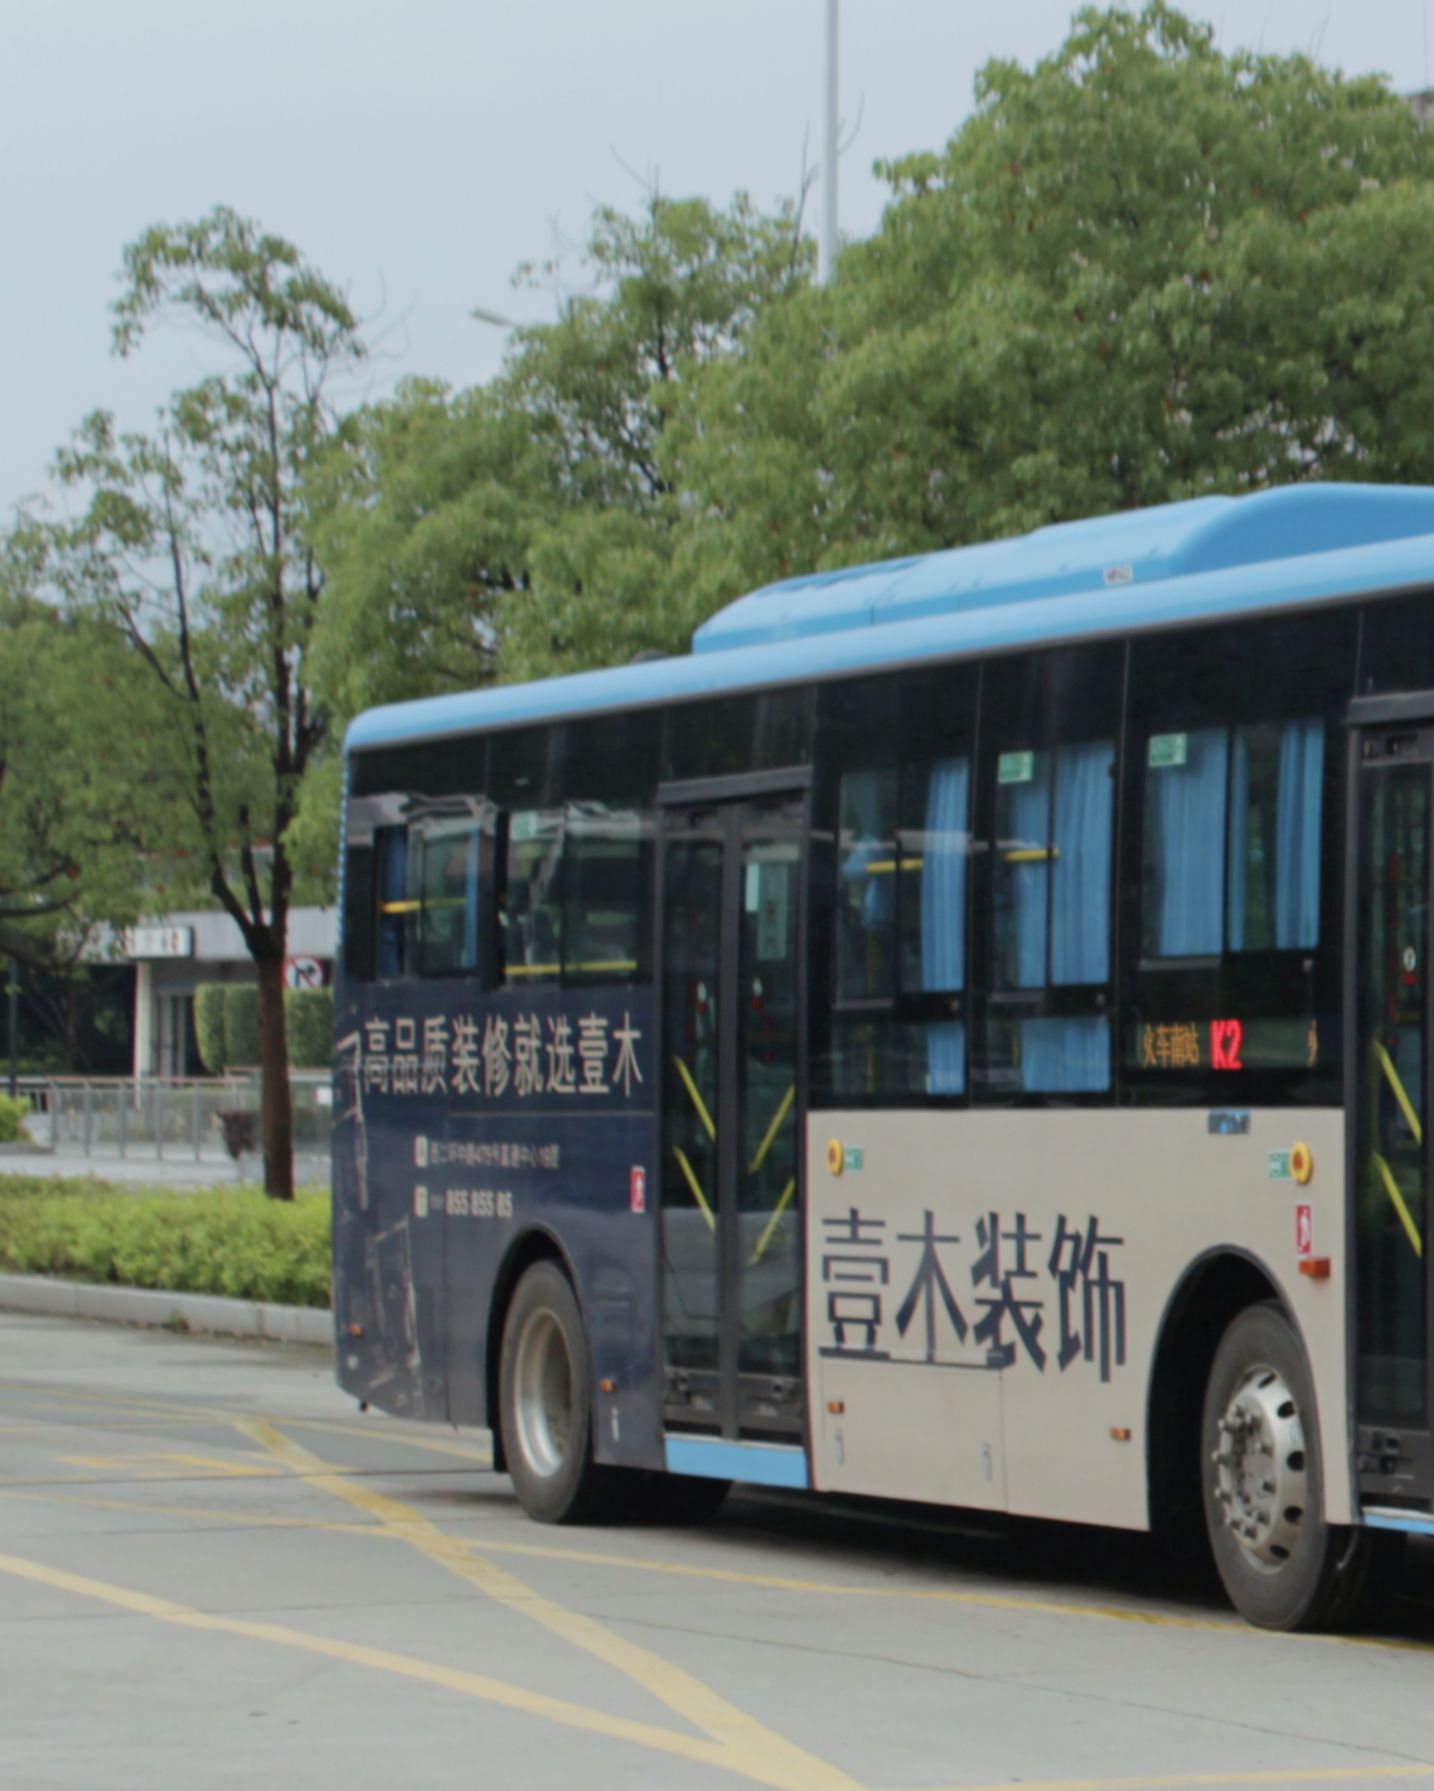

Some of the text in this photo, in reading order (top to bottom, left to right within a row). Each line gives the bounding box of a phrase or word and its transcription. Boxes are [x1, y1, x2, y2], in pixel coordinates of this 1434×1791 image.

[364, 1010, 644, 1097] 高品质装修就选壹木
[1209, 1018, 1243, 1069] K2
[818, 1206, 1126, 1383] 壹木装饰
